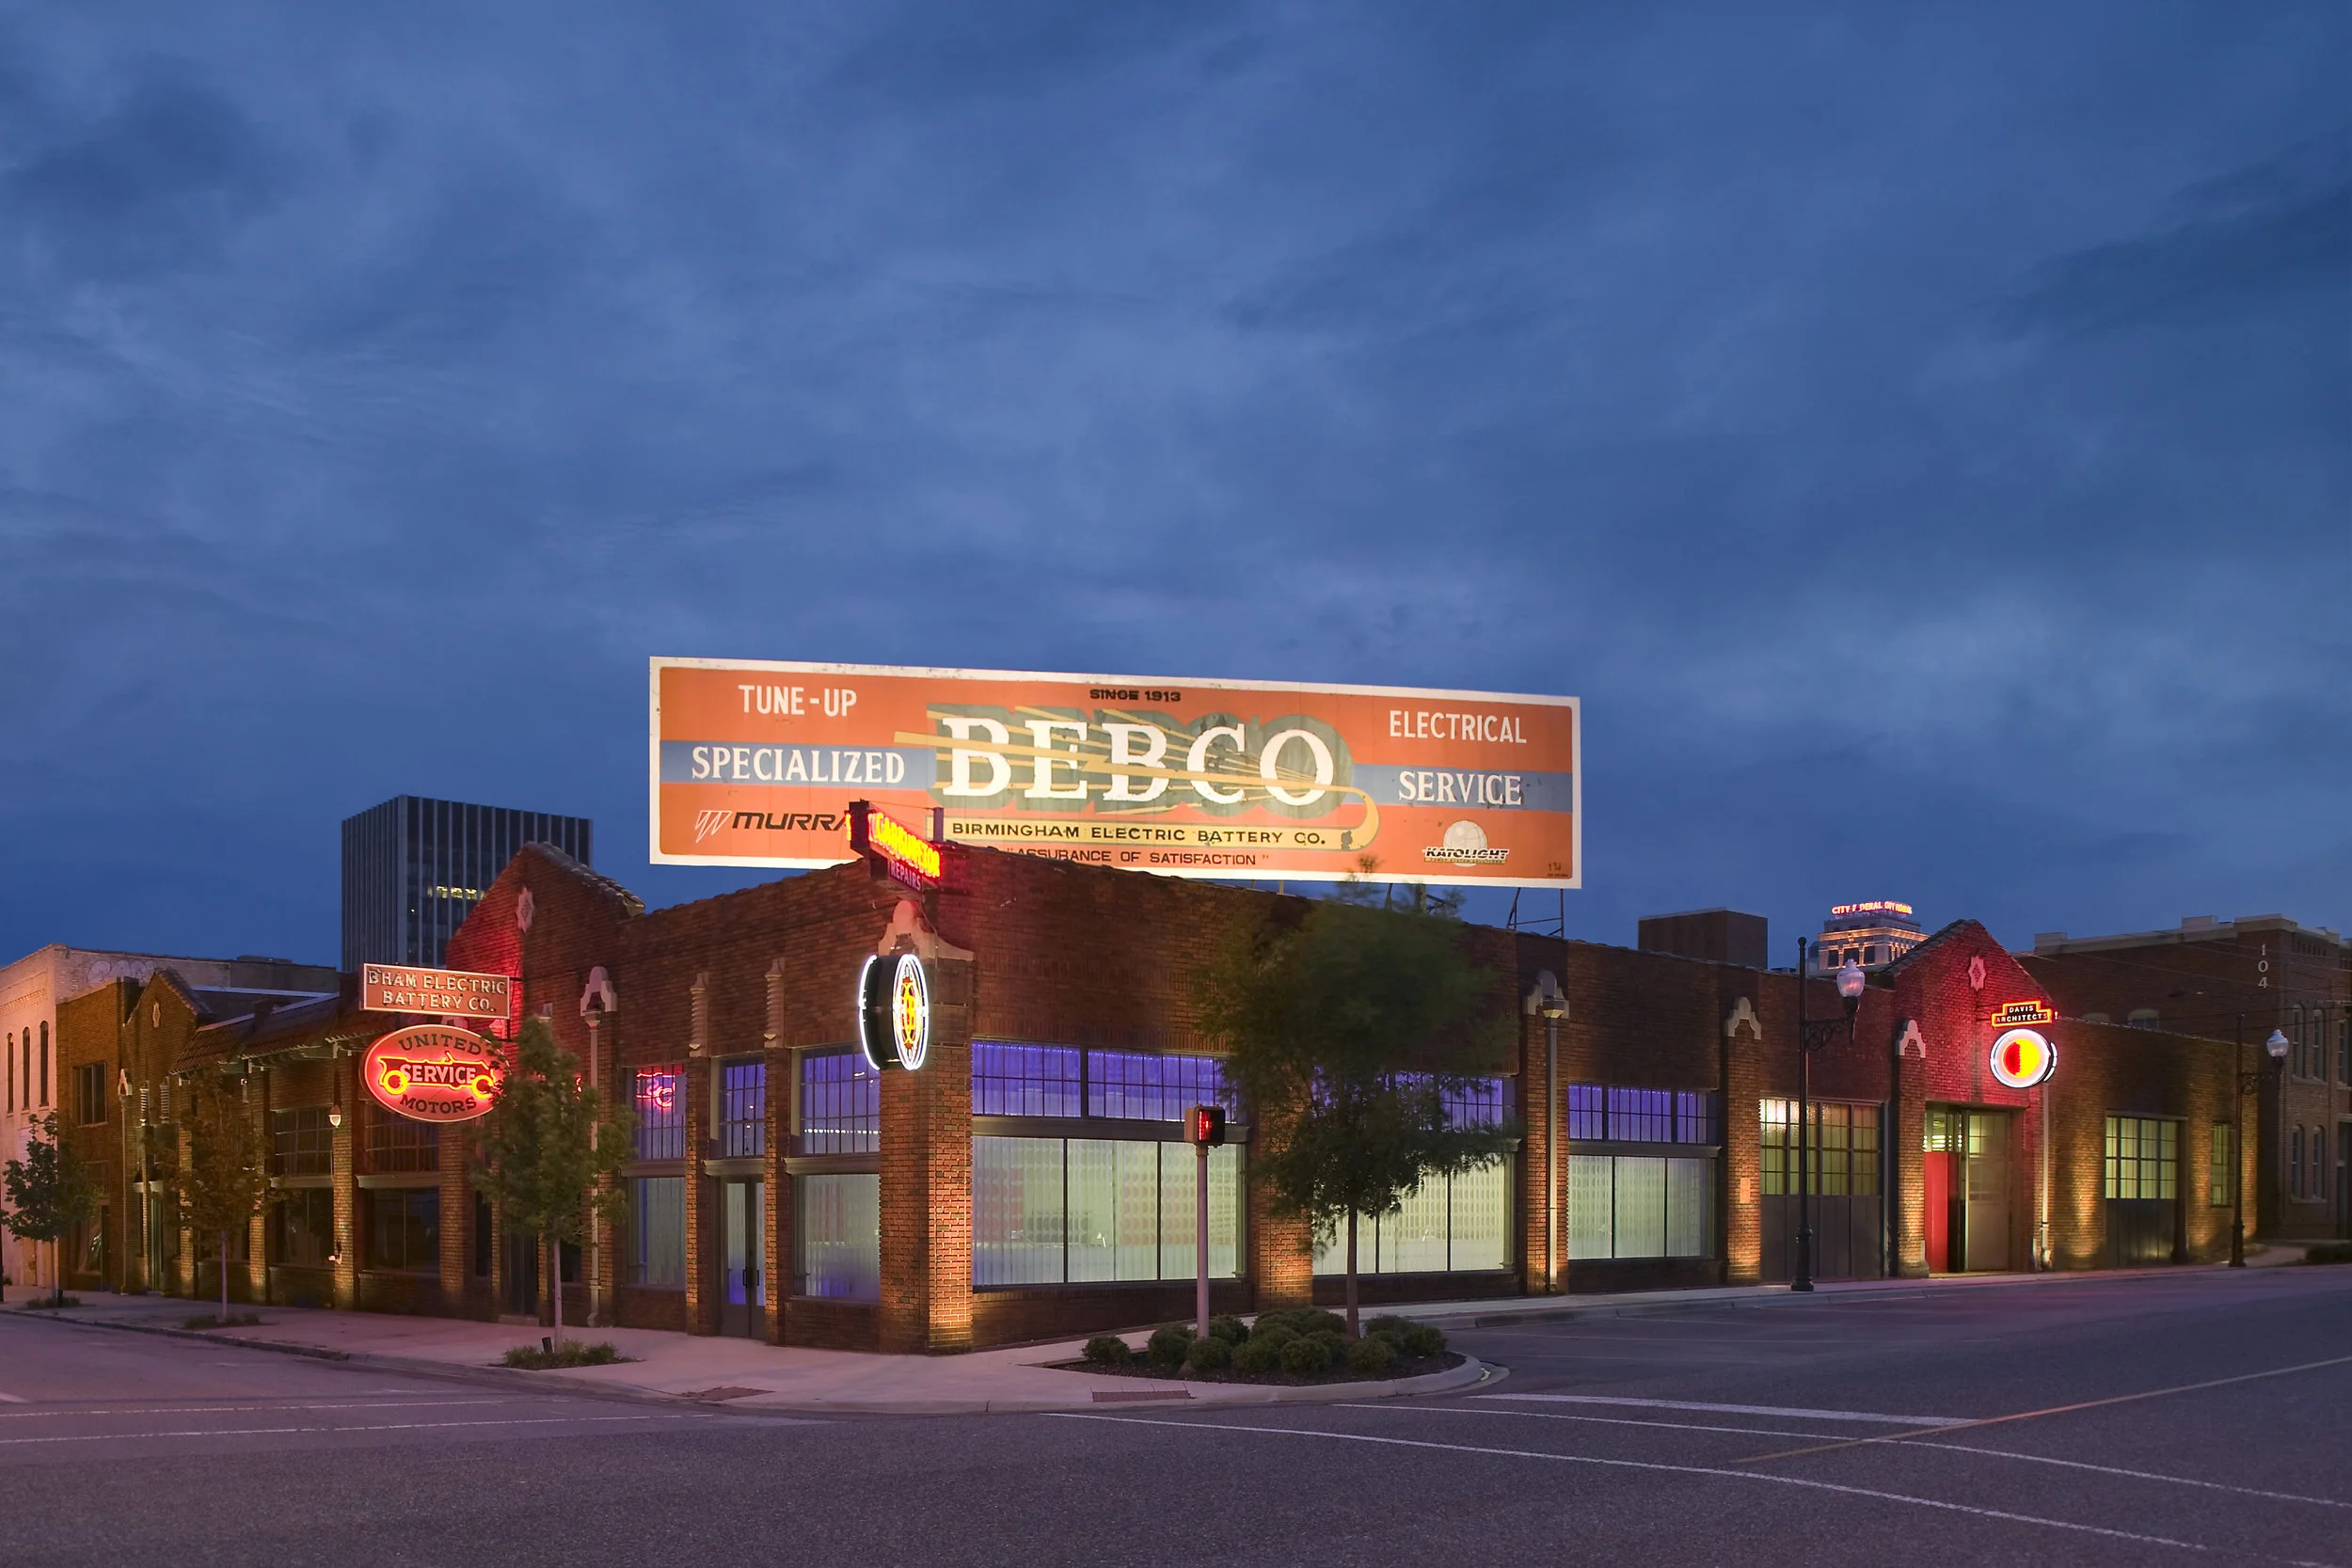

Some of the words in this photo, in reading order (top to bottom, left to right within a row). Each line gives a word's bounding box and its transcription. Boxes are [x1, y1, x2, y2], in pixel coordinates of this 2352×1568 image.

[739, 685, 857, 718] TUNE-UP
[1144, 690, 1182, 703] 1913
[1390, 710, 1527, 744] ELECTRICAL
[691, 746, 906, 784] SPECIALIZED
[942, 718, 1334, 806] BEBCO
[1398, 771, 1522, 806] SERVICE
[952, 823, 1079, 838] BIRMINGHAM
[1091, 827, 1185, 841] ELECTRIC
[1198, 831, 1283, 843] BATTERY
[1295, 832, 1326, 845] CO.
[1120, 852, 1140, 863] OF
[1425, 847, 1509, 860] KATOLIGHT
[890, 860, 921, 891] REPAIRS
[1832, 905, 1850, 914] CITY
[423, 975, 506, 994] ELECTRIC
[382, 990, 463, 1008] BATTERY
[468, 997, 495, 1012] CO.
[1995, 1013, 2048, 1023] ARCHITECTS
[399, 1034, 482, 1055] UNITED
[399, 1063, 477, 1085] SERVICE
[399, 1095, 477, 1114] MOTORS
